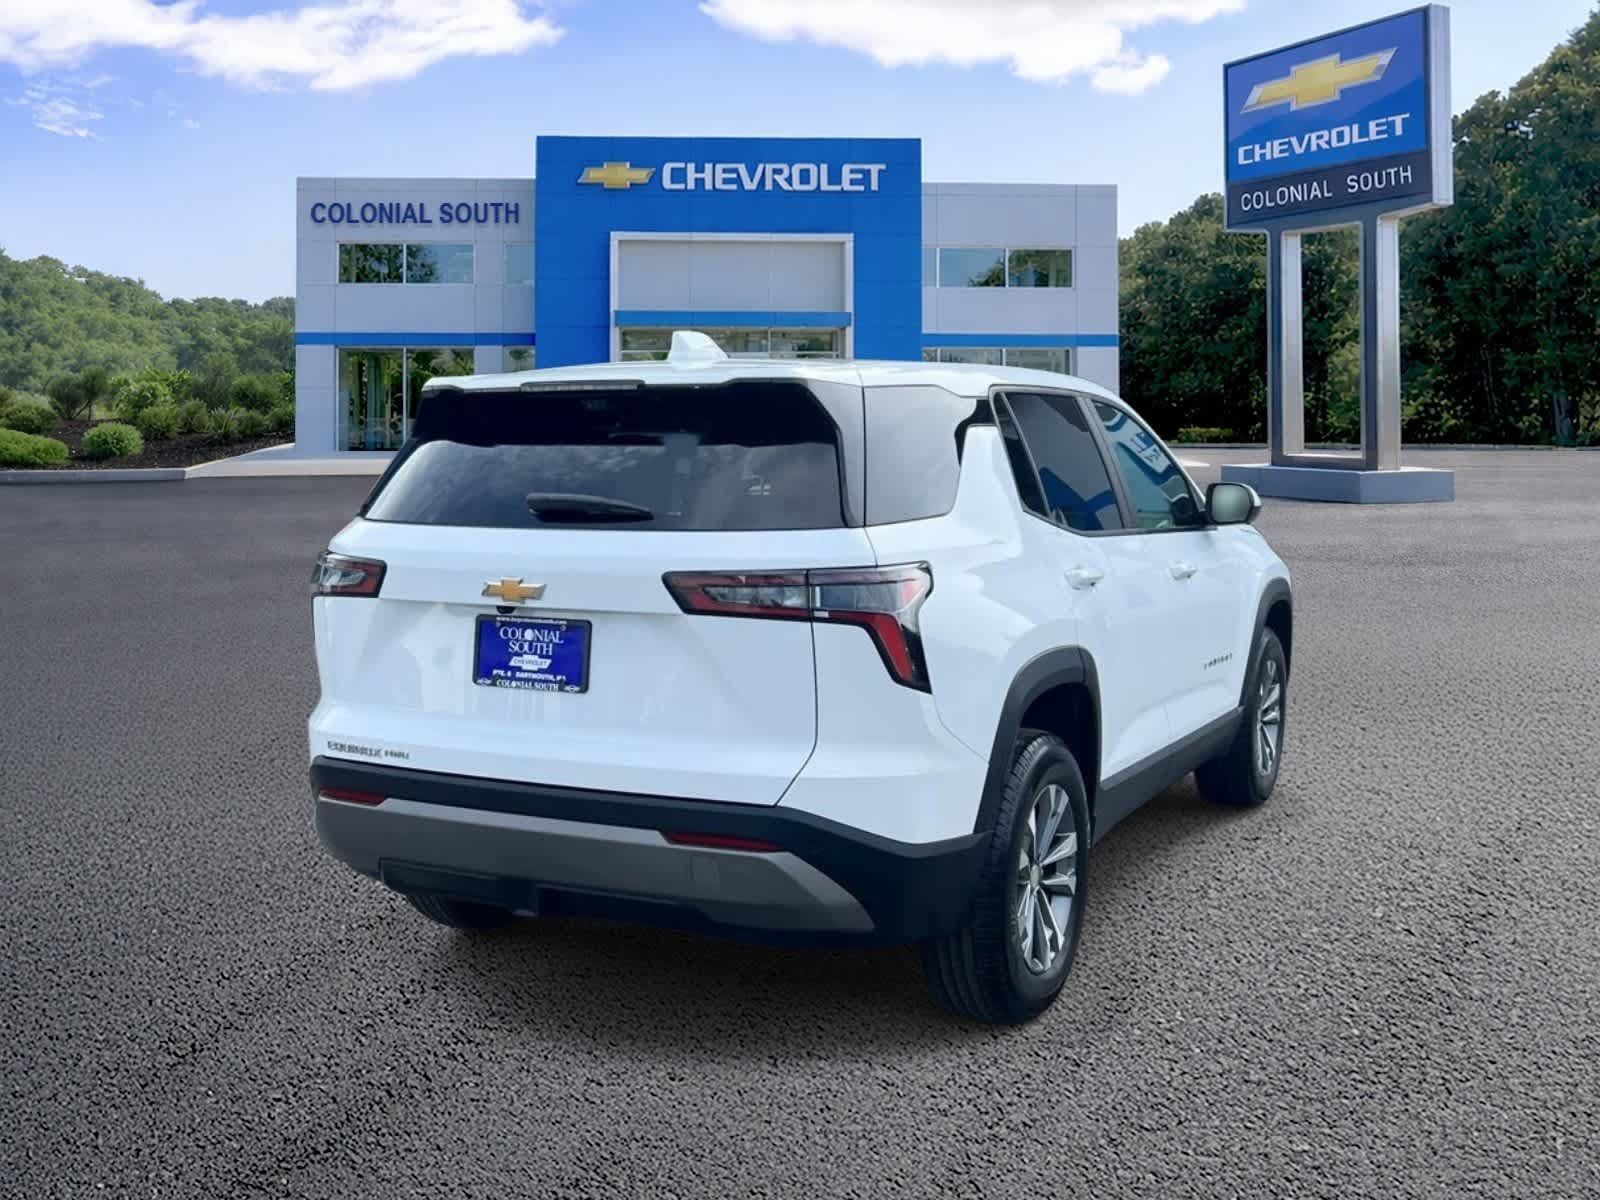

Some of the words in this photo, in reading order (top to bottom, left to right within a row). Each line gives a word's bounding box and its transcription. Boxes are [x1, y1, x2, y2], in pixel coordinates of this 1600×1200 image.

[1237, 112, 1410, 165] CHEVROLET
[661, 162, 887, 191] CHEVROLET
[1240, 180, 1333, 211] COLONIAL
[1346, 165, 1412, 193] SOUTH
[310, 202, 432, 224] COLONIAL
[439, 202, 520, 224] SOUTH
[499, 626, 563, 644] COLONIAL
[508, 640, 552, 656] SOUTH
[534, 681, 559, 691] SOUTH
